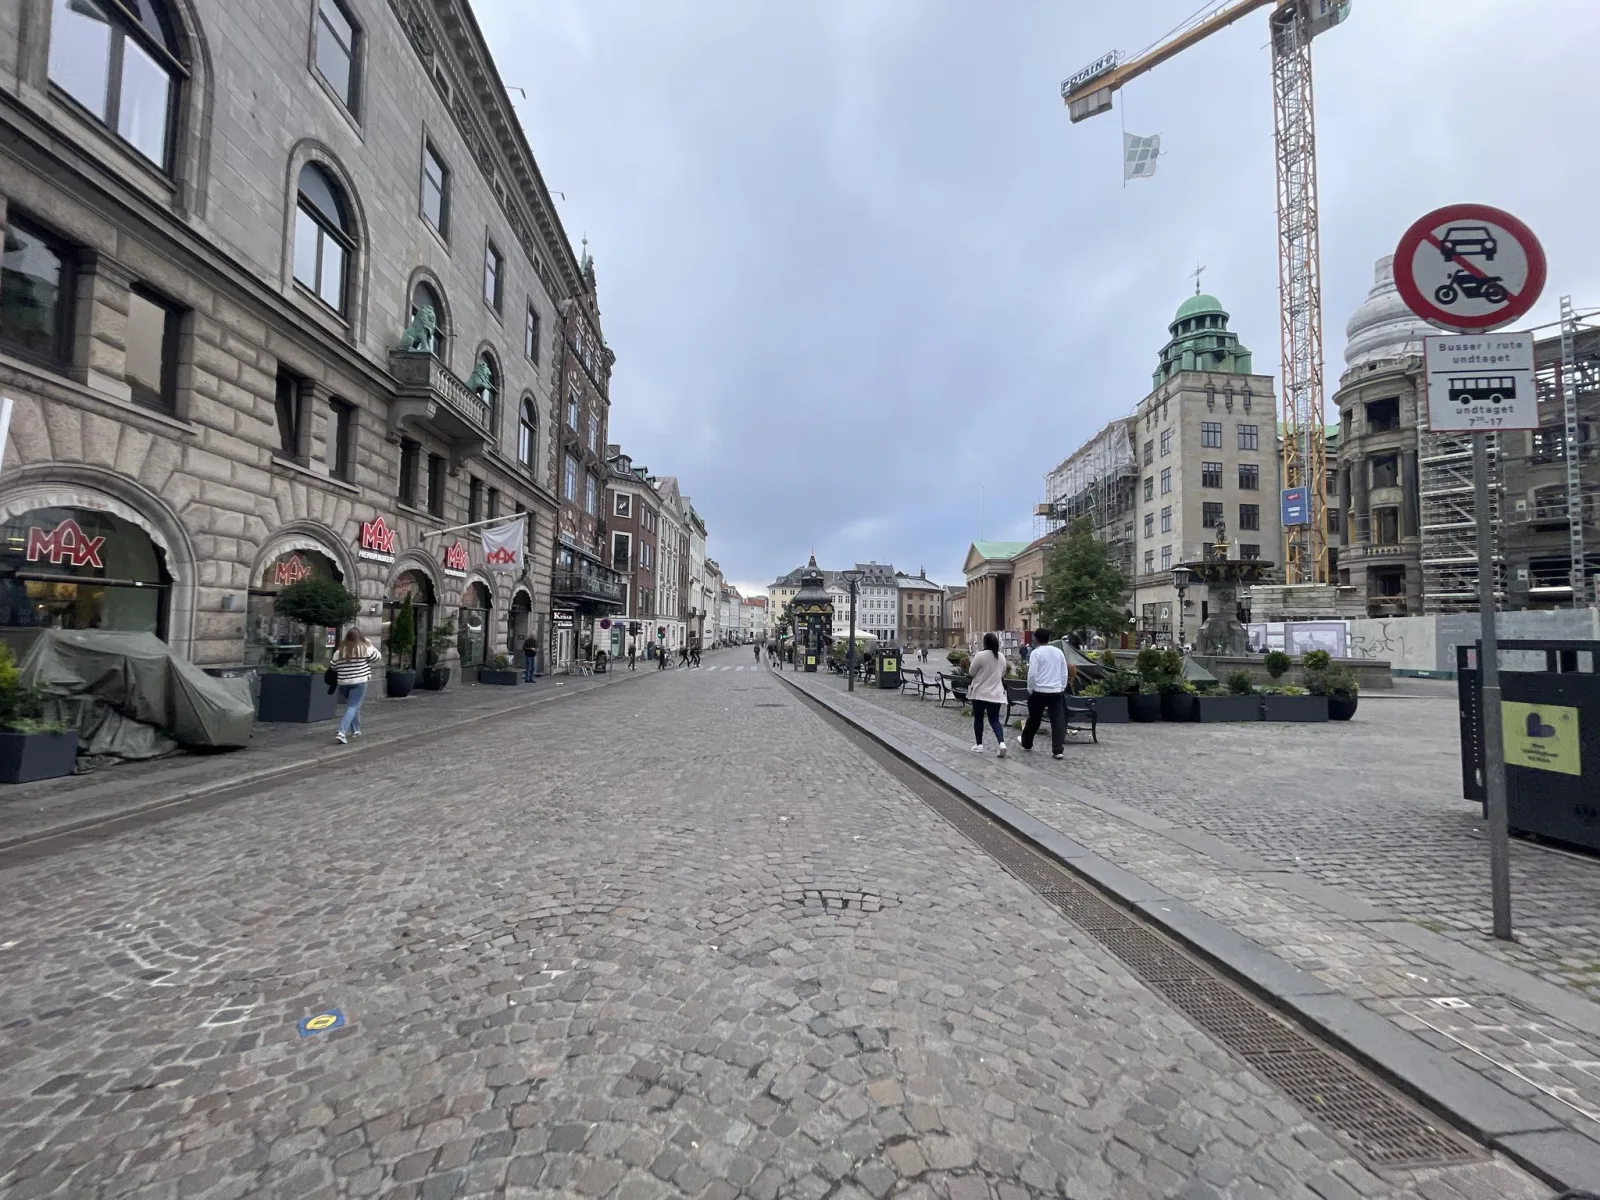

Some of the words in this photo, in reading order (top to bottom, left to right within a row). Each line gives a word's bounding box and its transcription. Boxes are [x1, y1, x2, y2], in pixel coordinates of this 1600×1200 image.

[1062, 59, 1103, 91] POTAIN
[1438, 343, 1482, 352] Busser
[1487, 342, 1491, 350] i
[1496, 341, 1522, 350] rute
[1452, 354, 1511, 364] undtaget
[1455, 405, 1514, 415] undtaget
[26, 518, 106, 568] MAX
[362, 516, 396, 554] MAX
[447, 541, 469, 571] MAX
[487, 546, 517, 564] MAX
